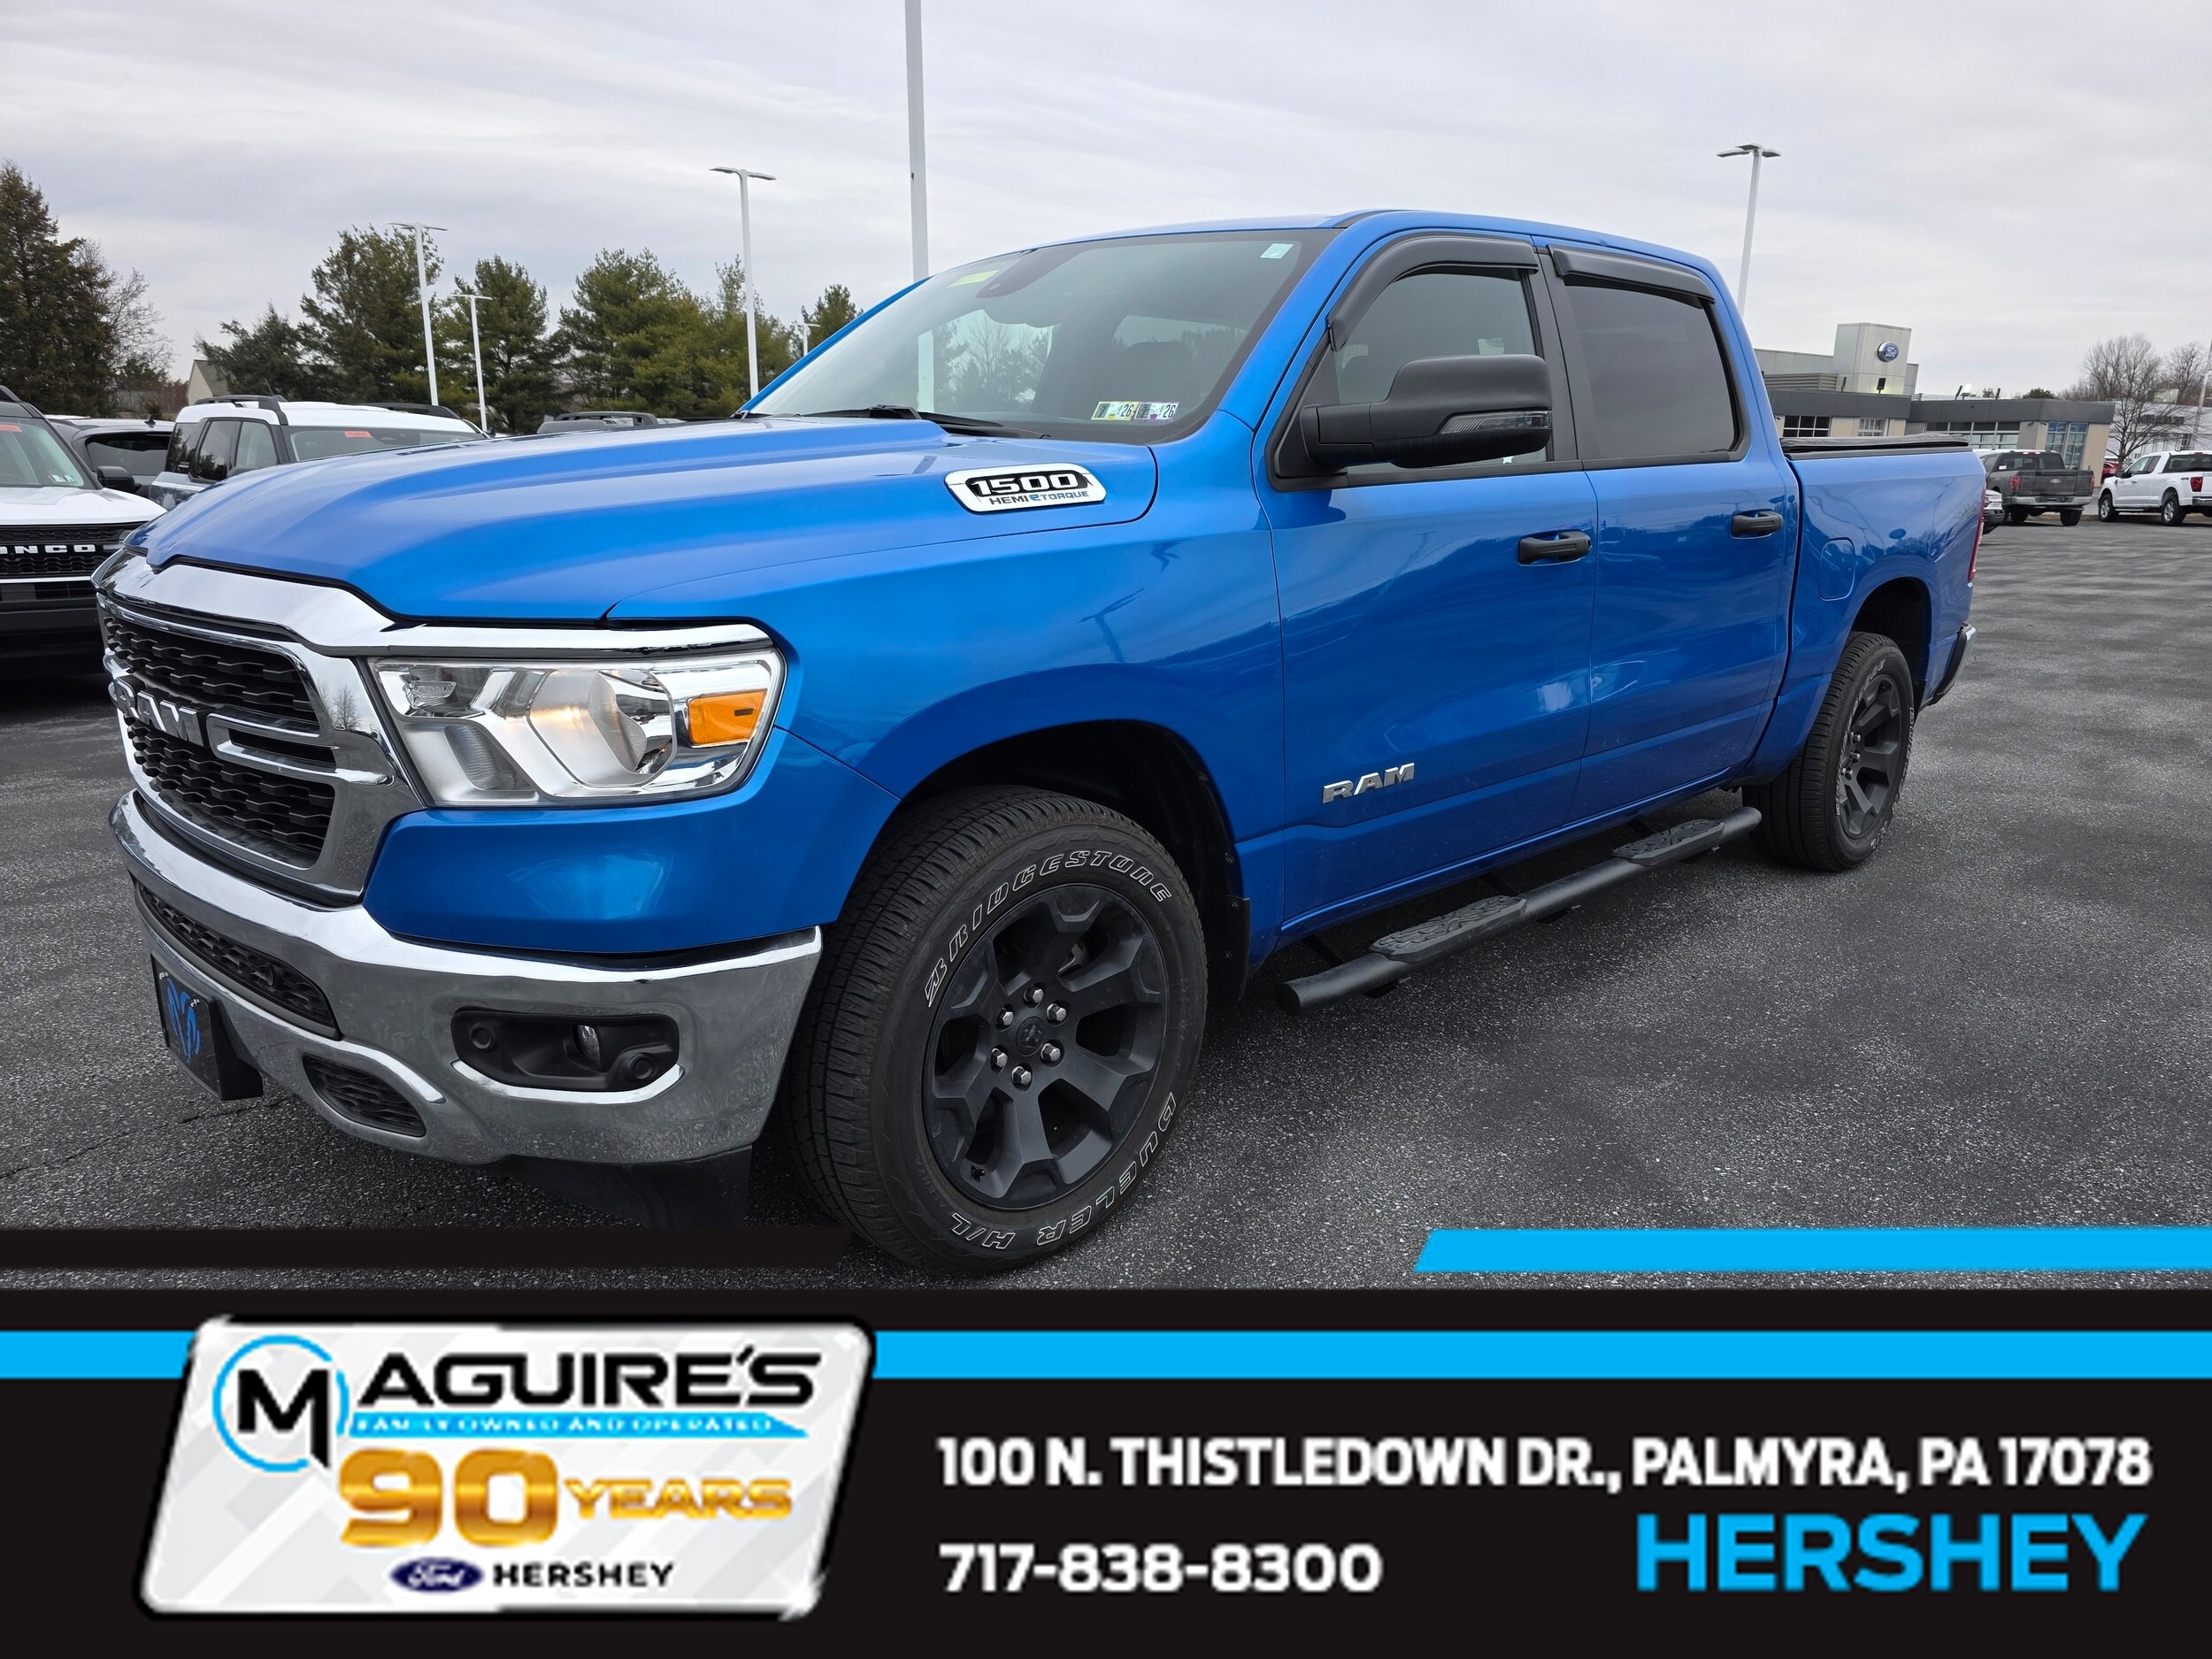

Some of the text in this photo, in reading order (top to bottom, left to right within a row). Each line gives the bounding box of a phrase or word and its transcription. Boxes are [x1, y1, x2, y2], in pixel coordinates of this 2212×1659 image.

[1120, 403, 1134, 417] 26
[1163, 404, 1176, 418] 26
[971, 473, 1079, 495] 1500
[989, 495, 1029, 505] HEMI
[113, 678, 204, 747] RAM
[1323, 763, 1415, 804] RAM
[925, 849, 1172, 1008] BRIDGESTONE
[1036, 1091, 1177, 1247] DUELER
[951, 1212, 1016, 1249] H/L
